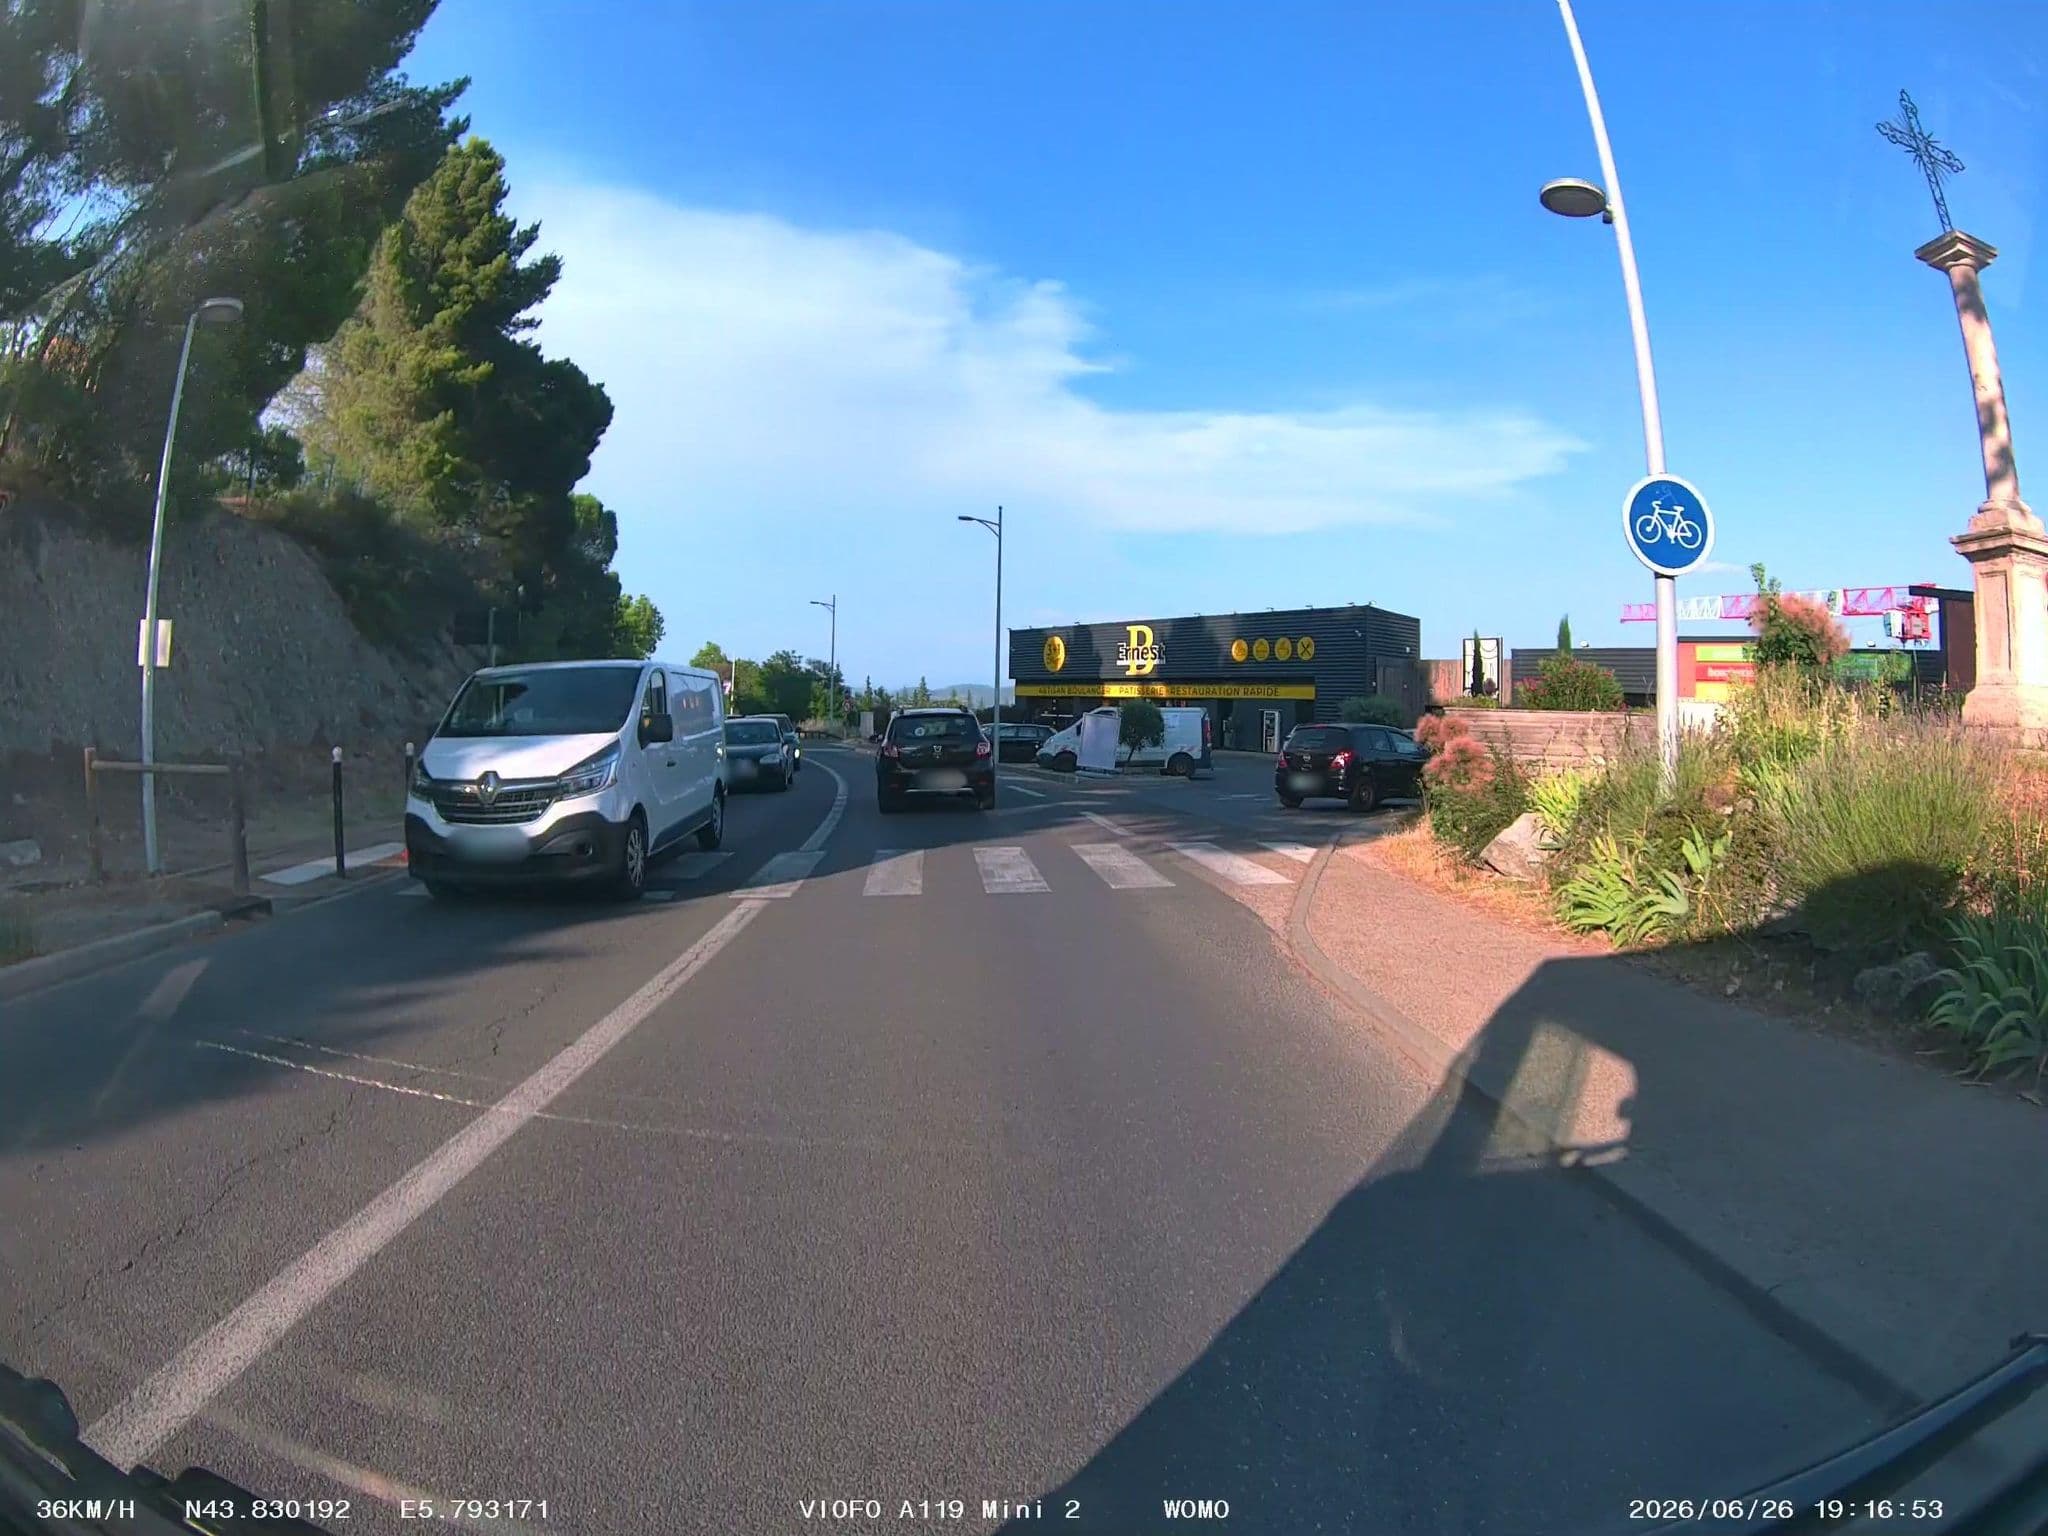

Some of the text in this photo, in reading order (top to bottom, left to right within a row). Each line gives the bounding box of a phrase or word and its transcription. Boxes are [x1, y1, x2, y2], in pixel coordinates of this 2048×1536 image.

[1116, 642, 1166, 661] Ernest
[1125, 624, 1154, 676] B
[1038, 686, 1066, 695] ARTISAN
[1067, 686, 1112, 696] BOULANGER
[1170, 686, 1240, 697] RESTAURATION
[1243, 687, 1280, 697] RAPIDE
